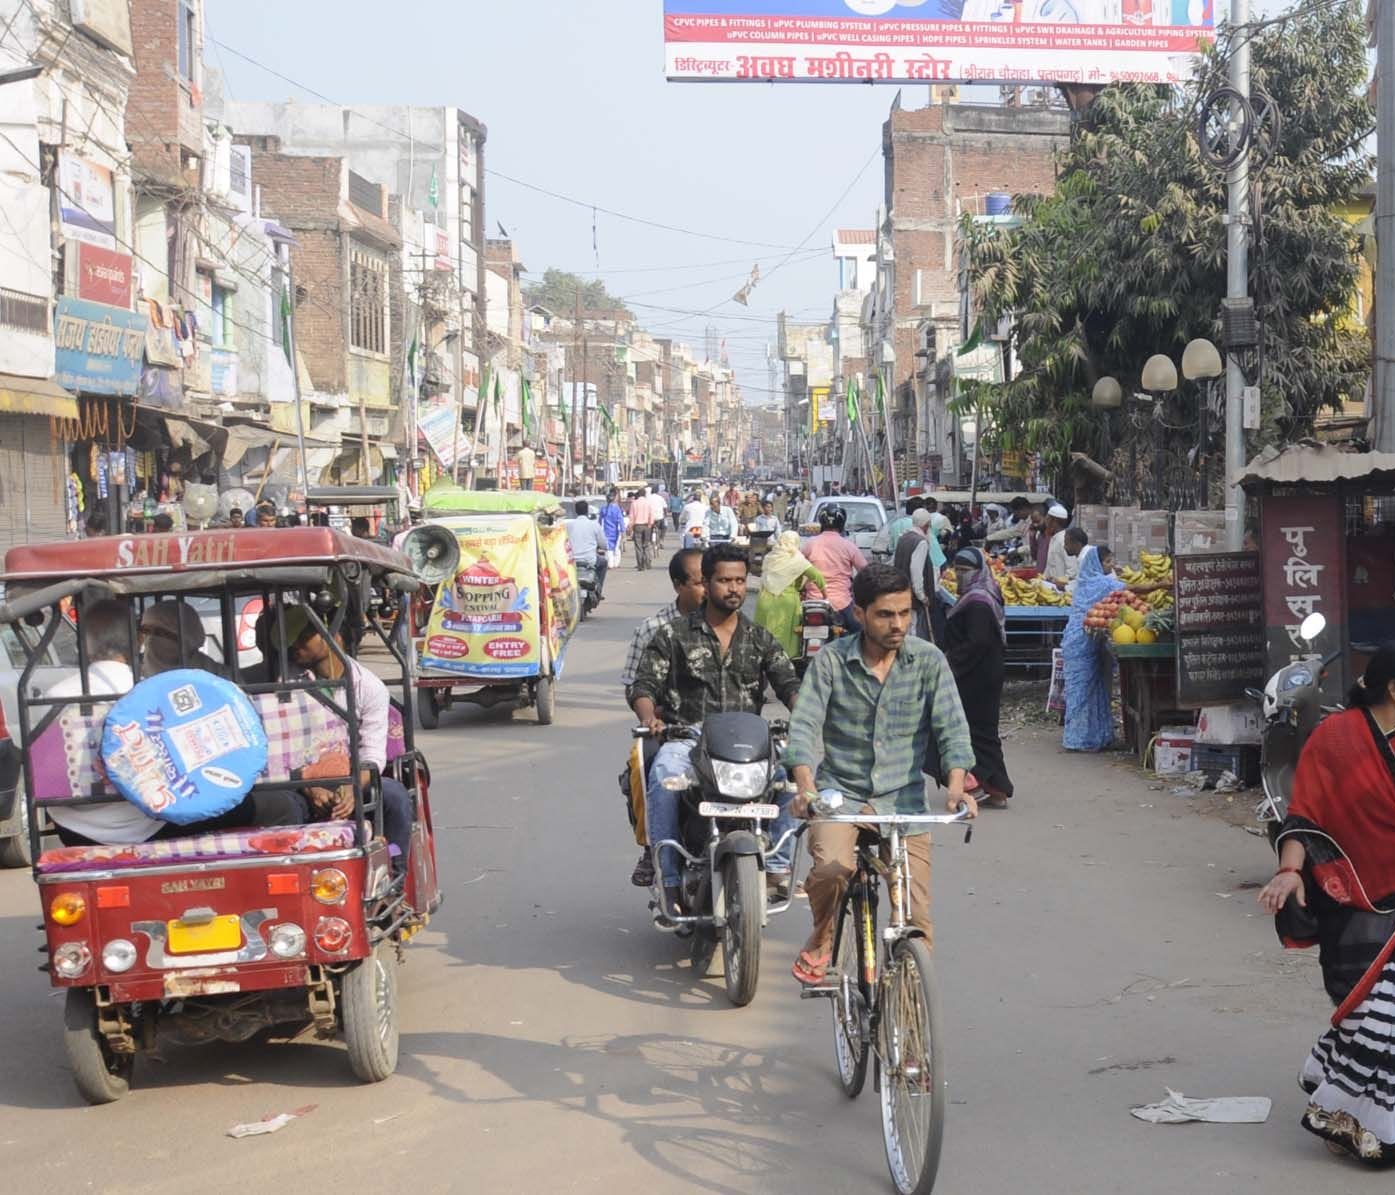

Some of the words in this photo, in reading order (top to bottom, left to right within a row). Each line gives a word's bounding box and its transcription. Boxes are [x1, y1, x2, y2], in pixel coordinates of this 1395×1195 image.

[697, 19, 718, 27] PIPES
[729, 20, 765, 28] FITTINGS
[796, 22, 838, 31] PLUMBING
[840, 23, 871, 31] SYSTEM
[901, 24, 940, 33] PRESSURE
[942, 25, 963, 33] PIPES
[972, 25, 1007, 34] FITTINGS
[1056, 27, 1095, 35] DRAINAGE
[1105, 28, 1158, 36] AGRICULTURE
[787, 32, 808, 40] PIPES
[839, 33, 859, 41] WELL
[861, 34, 894, 42] CASING
[895, 34, 915, 42] PIPES
[943, 35, 966, 43] PIPES
[975, 36, 1015, 44] SPRINKLER
[1016, 36, 1047, 45] SYSTEM
[1055, 37, 1082, 46] WATER
[1083, 38, 1108, 46] TANKS
[1115, 39, 1146, 47] GARDEN
[1147, 39, 1168, 48] PIPES
[804, 51, 895, 79] मशीनरी
[903, 52, 953, 80] स्टोर
[488, 641, 525, 650] ENTRY
